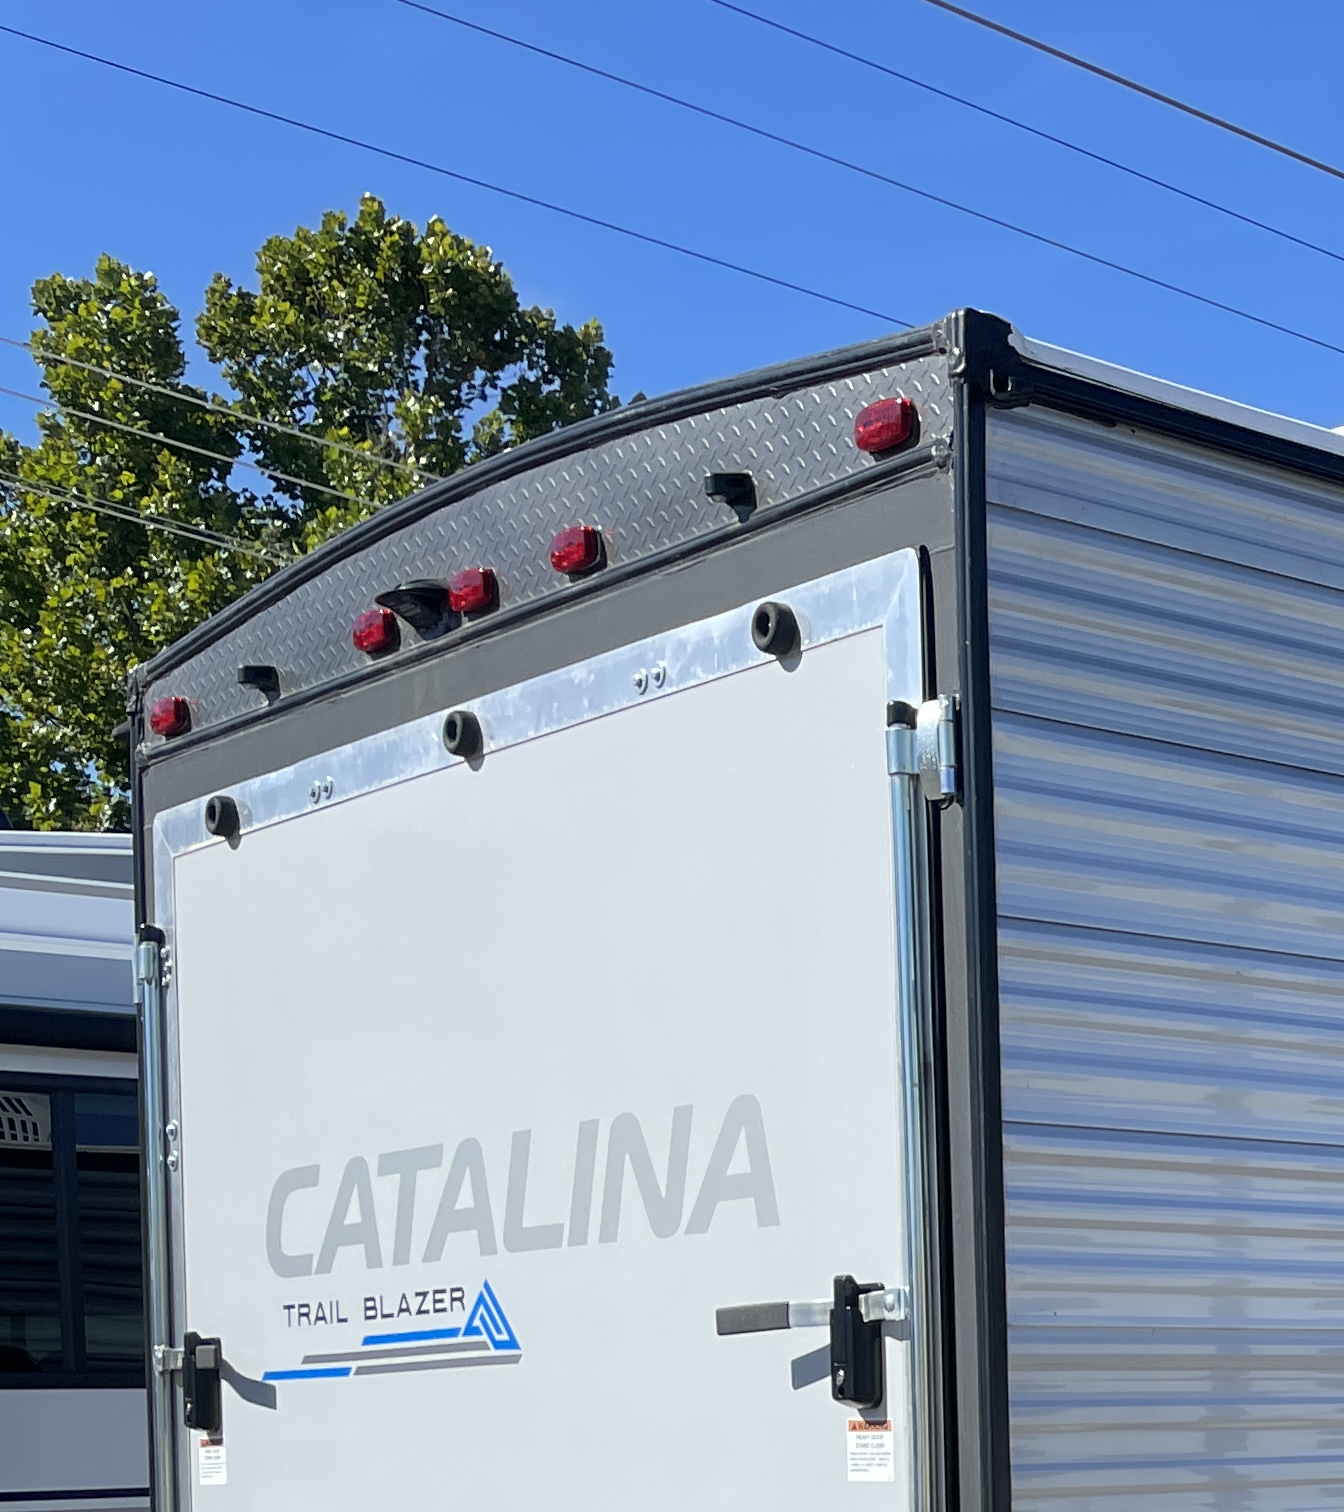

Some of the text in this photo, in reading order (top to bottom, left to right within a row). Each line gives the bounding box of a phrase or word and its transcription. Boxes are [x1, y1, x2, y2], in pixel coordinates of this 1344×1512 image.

[265, 1094, 781, 1278] CATALINA
[283, 1286, 466, 1328] TRAIL BLAZER
